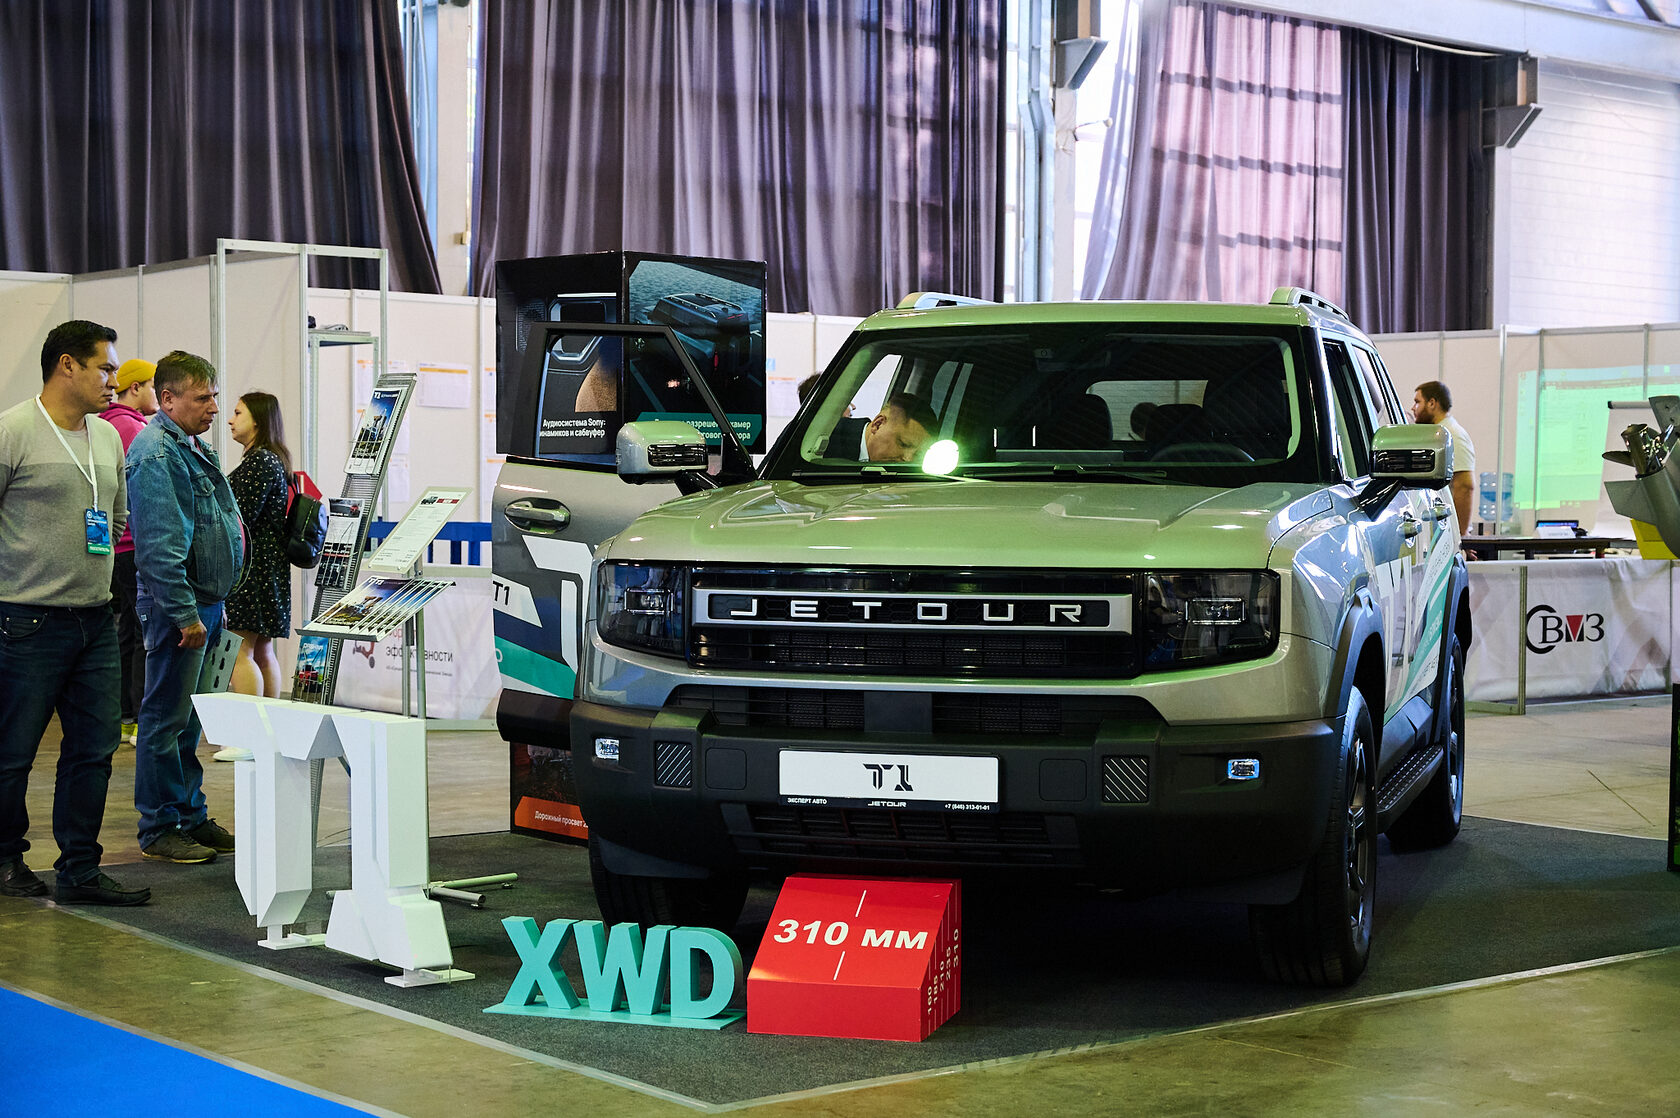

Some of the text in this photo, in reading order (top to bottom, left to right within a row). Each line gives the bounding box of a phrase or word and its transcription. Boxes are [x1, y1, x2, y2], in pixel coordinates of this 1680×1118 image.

[543, 418, 606, 429] Аудиосистема Sony:
[575, 428, 606, 438] сабвуфер
[493, 581, 510, 606] T1
[730, 598, 1082, 623] JETOUR
[863, 763, 914, 792] T1
[535, 810, 561, 823] Дорожный
[562, 817, 583, 827] просвет
[773, 919, 849, 946] 310
[501, 916, 743, 1019] XWD
